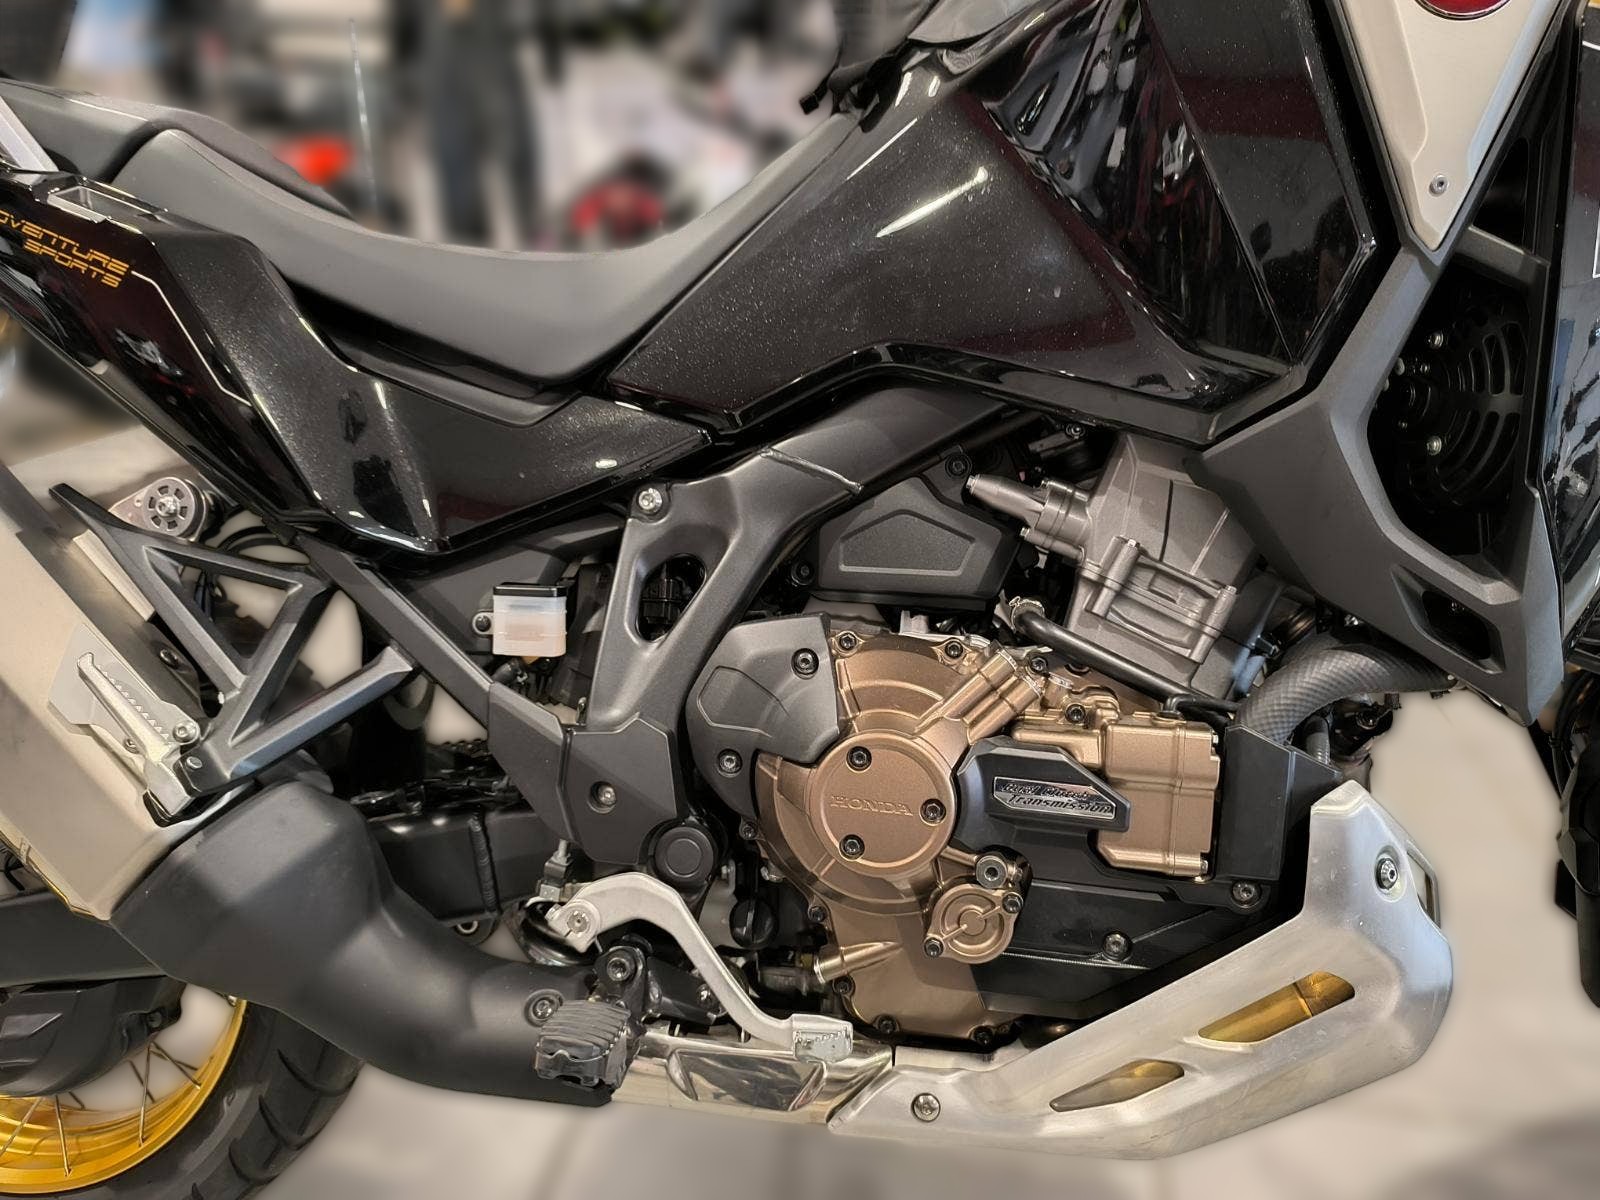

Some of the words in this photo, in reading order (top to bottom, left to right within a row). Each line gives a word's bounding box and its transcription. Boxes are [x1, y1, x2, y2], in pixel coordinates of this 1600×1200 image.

[24, 239, 122, 288] SPORTS
[830, 795, 913, 817] HONDA
[1008, 794, 1113, 815] Transmission
